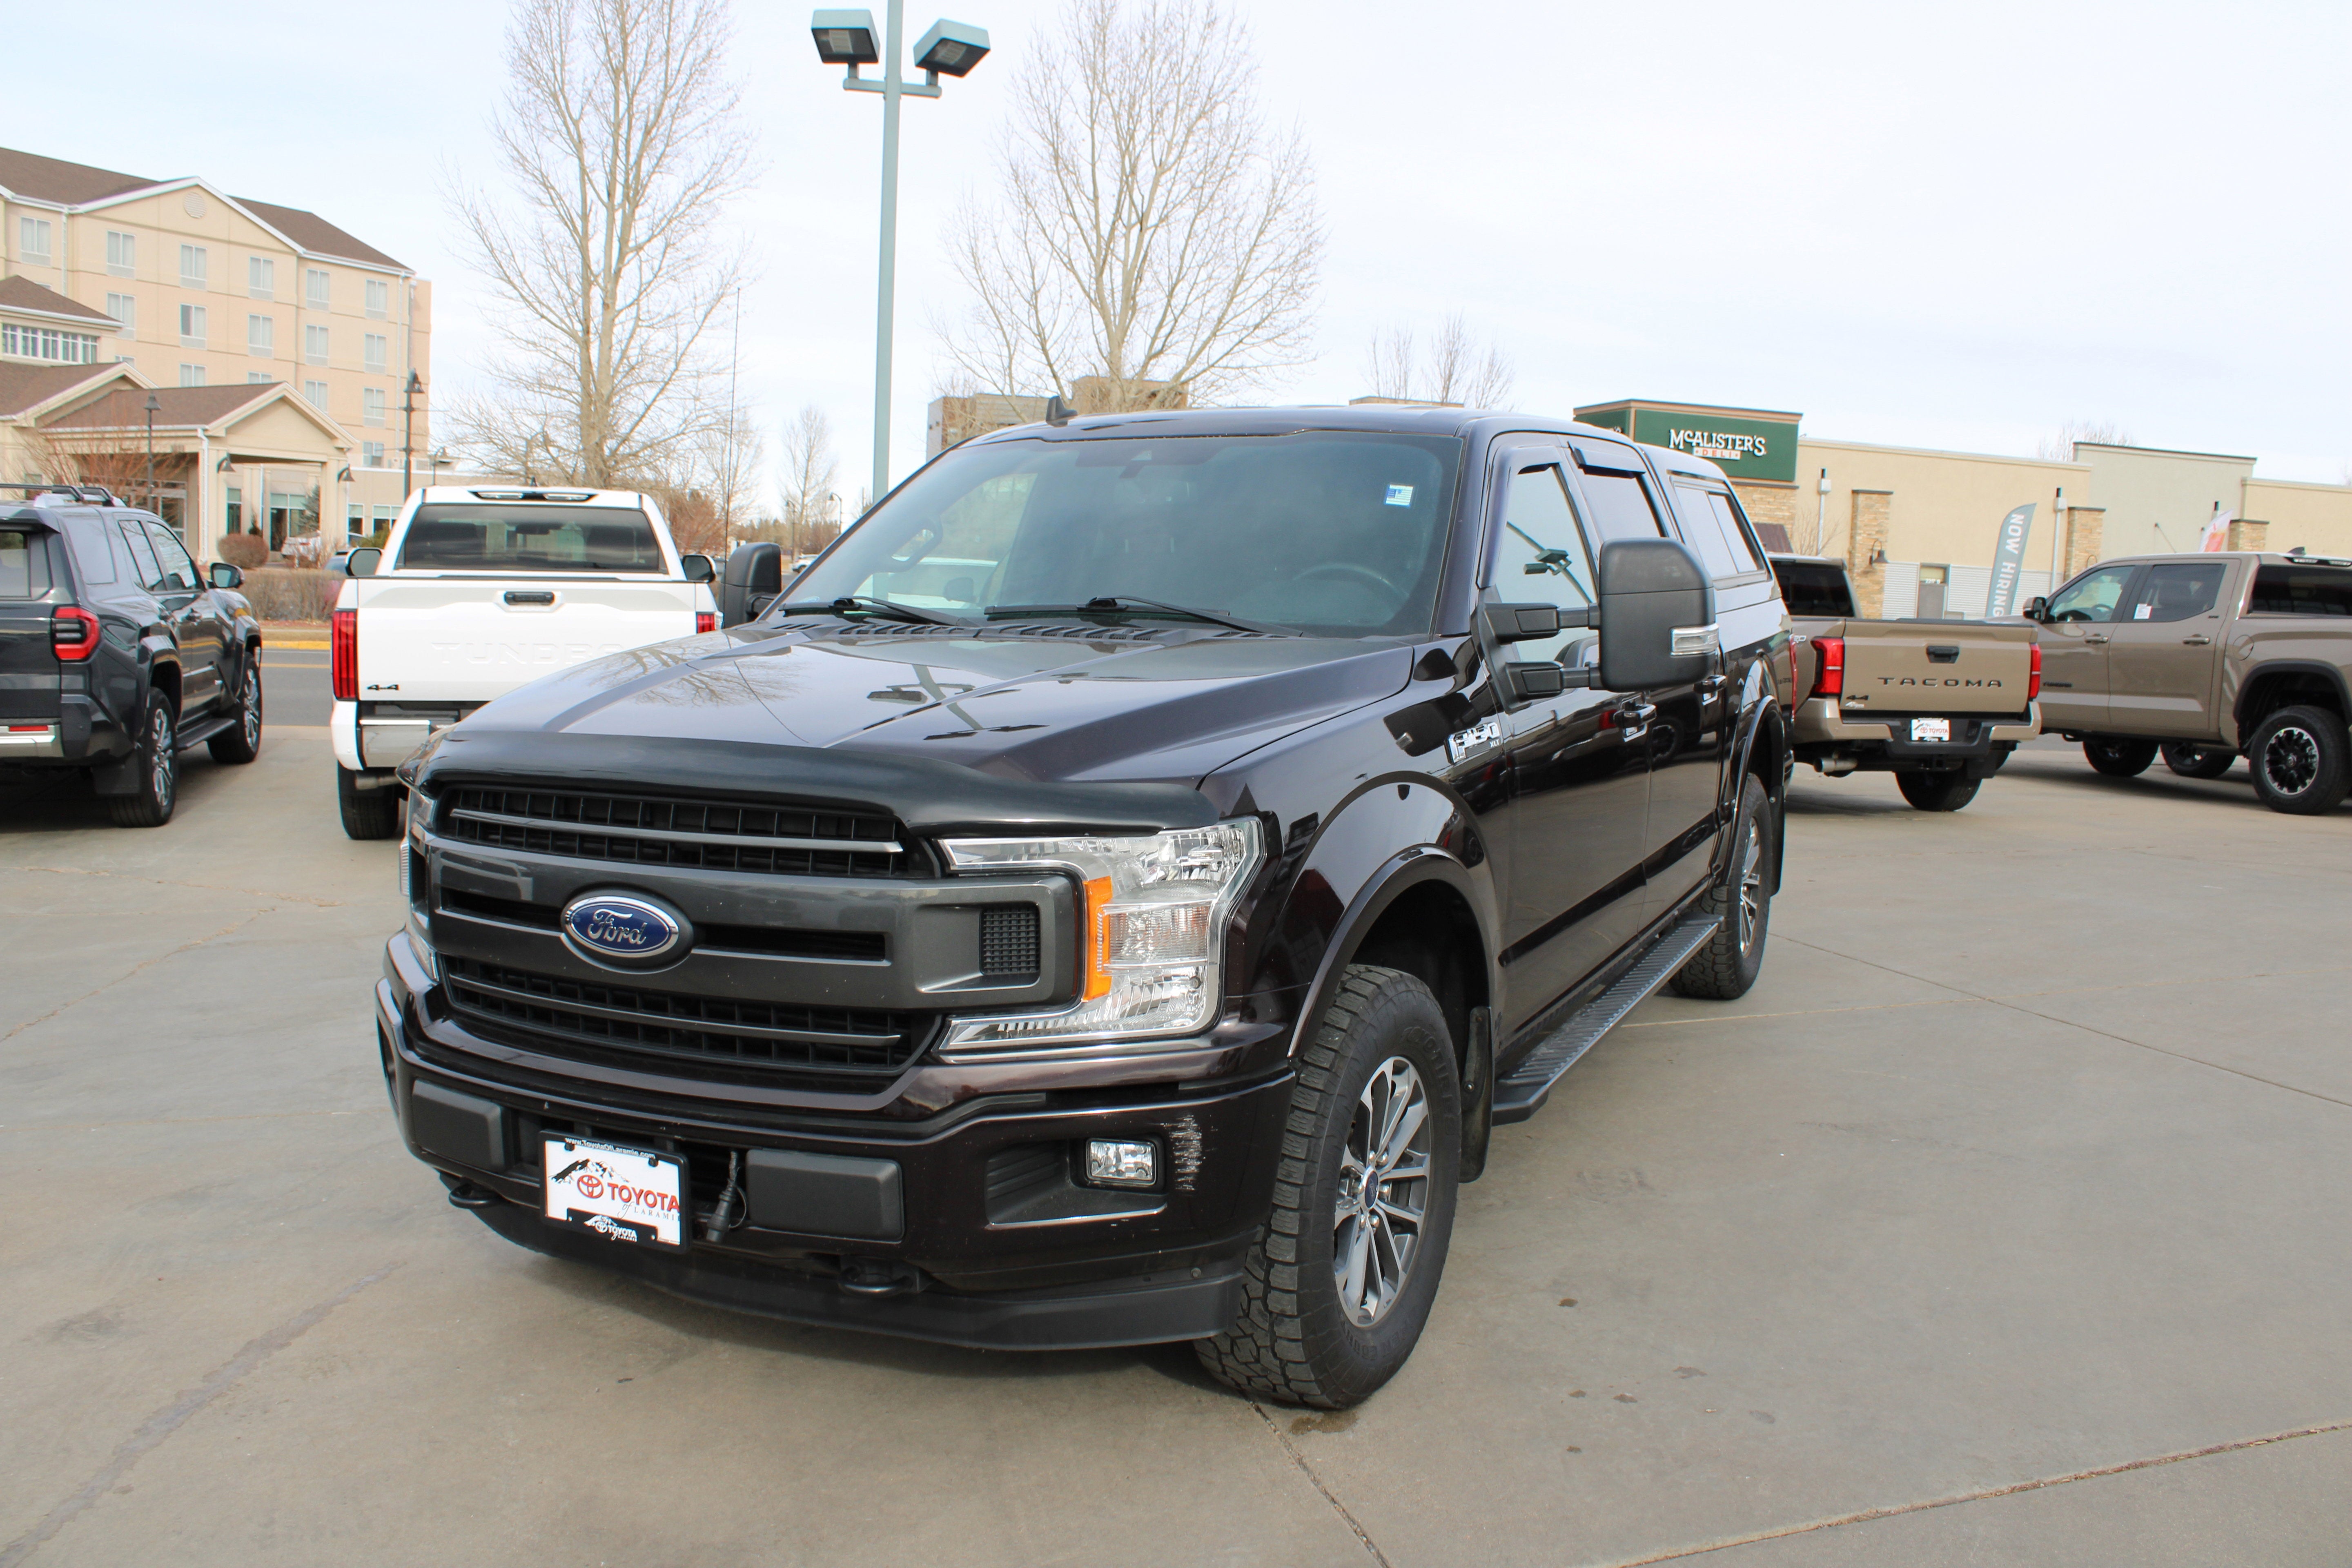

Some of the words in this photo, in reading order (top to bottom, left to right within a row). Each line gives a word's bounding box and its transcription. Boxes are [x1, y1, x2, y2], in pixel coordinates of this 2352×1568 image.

[1702, 448, 1732, 459] DELI
[2005, 514, 2025, 555] NOW
[1993, 561, 2016, 617] HIRING
[1877, 677, 2002, 688] TACOMA
[1489, 739, 1500, 748] XLT
[587, 908, 648, 945] Ford
[565, 1138, 656, 1160] www.ToyotaOfLaramie.com
[607, 1182, 680, 1213] TOYOTA
[617, 1201, 635, 1221] of
[608, 1225, 637, 1238] TOYOTA
